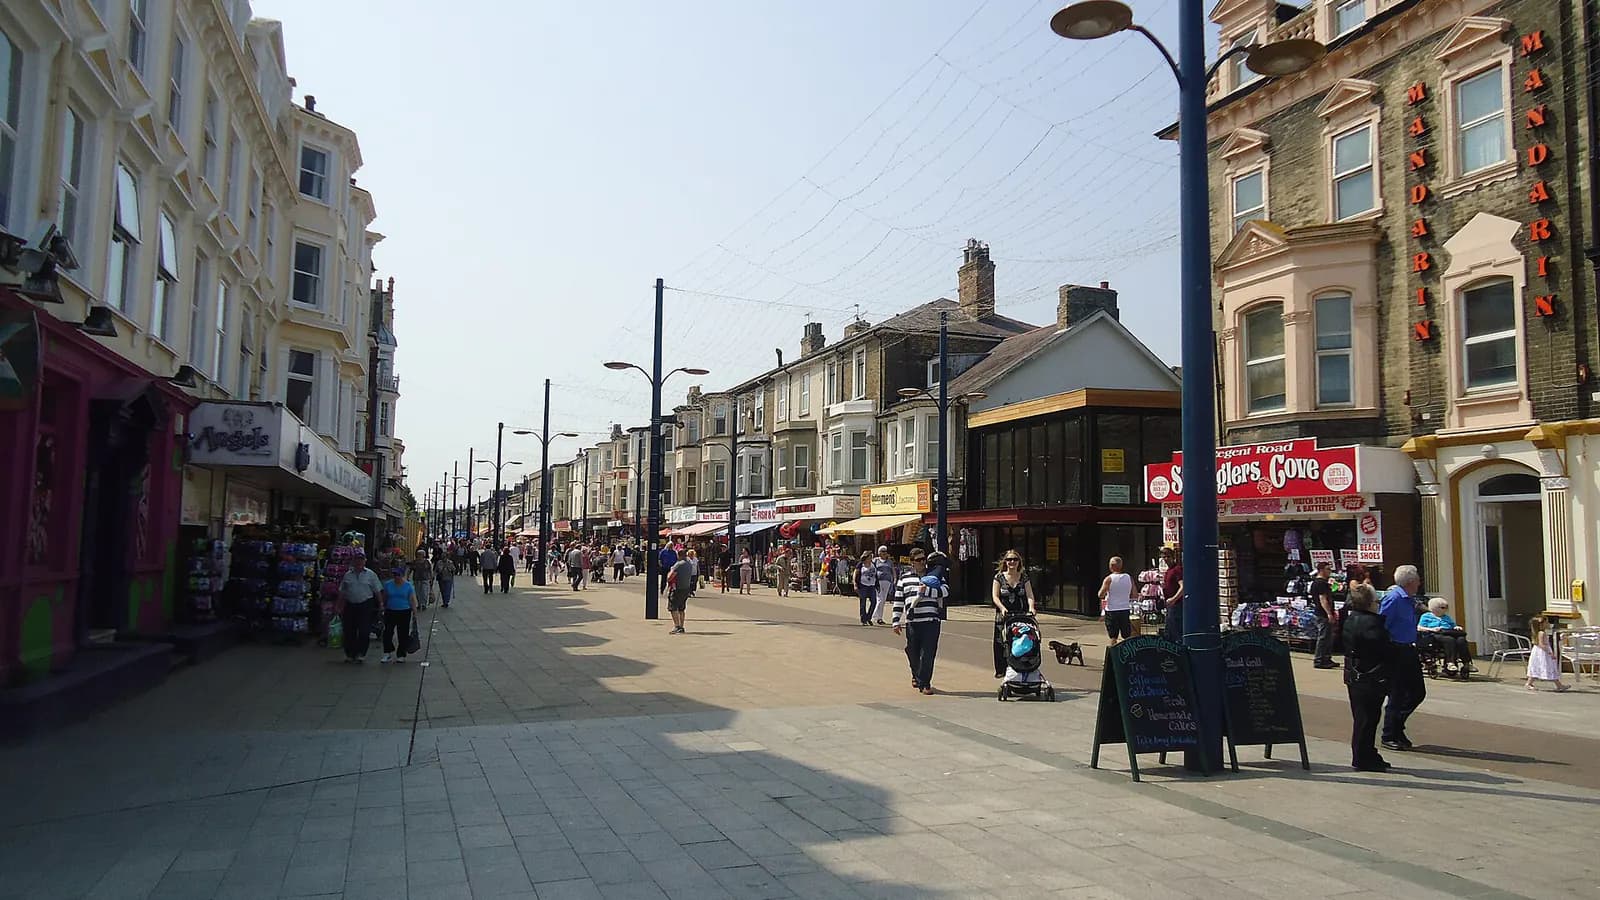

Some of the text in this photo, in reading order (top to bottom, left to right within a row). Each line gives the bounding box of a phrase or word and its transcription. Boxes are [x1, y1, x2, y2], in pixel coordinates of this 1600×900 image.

[1520, 30, 1555, 317] MANDARIN
[1407, 82, 1431, 341] MANDARIN
[192, 427, 269, 453] Angels
[1256, 443, 1294, 454] Road
[1170, 460, 1262, 495] Sglers
[1269, 454, 1320, 489] Cove
[1292, 497, 1315, 505] WATCH
[1315, 495, 1340, 504] STRAPS
[1302, 504, 1337, 512] BATTERIES
[757, 509, 767, 519] FISH
[1360, 543, 1380, 552] BEACH
[1360, 552, 1380, 560] SHOES
[1146, 708, 1193, 720] Homemade
